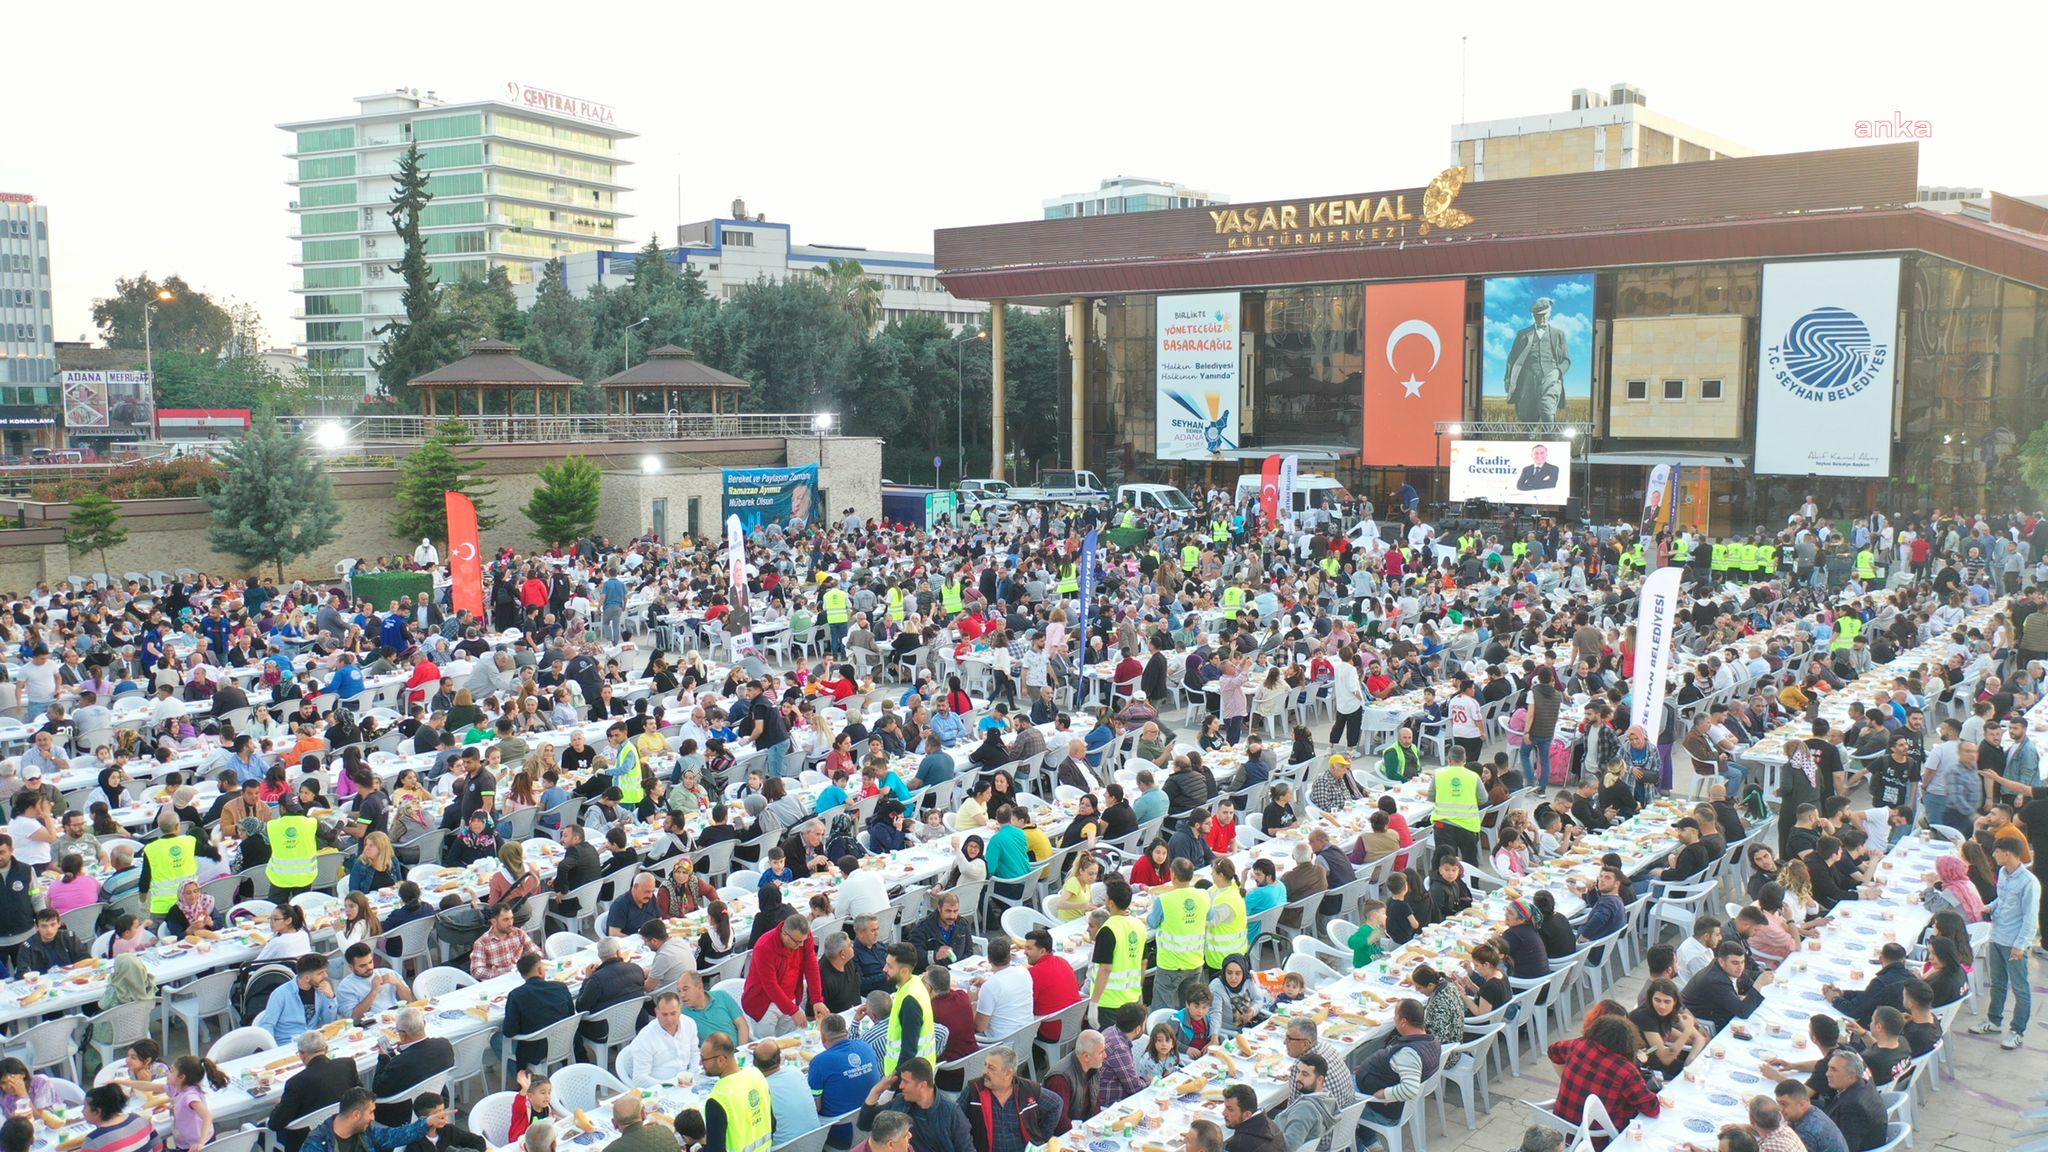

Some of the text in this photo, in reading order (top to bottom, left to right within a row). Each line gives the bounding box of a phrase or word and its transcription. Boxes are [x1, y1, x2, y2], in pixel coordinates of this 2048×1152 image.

[581, 103, 614, 121] PLAZA
[1209, 195, 1412, 234] YAŞAR KEMAL
[1195, 361, 1234, 370] Belediyesi
[67, 373, 101, 382] ADANA
[1776, 370, 1824, 402] SEYHAN
[1171, 419, 1204, 429] SEYHAN
[1174, 433, 1204, 441] ADANA
[1476, 456, 1510, 466] Kadir
[1468, 465, 1517, 475] Gecemiz
[756, 497, 774, 506] Olsun
[1641, 672, 1656, 725] SEYHAN
